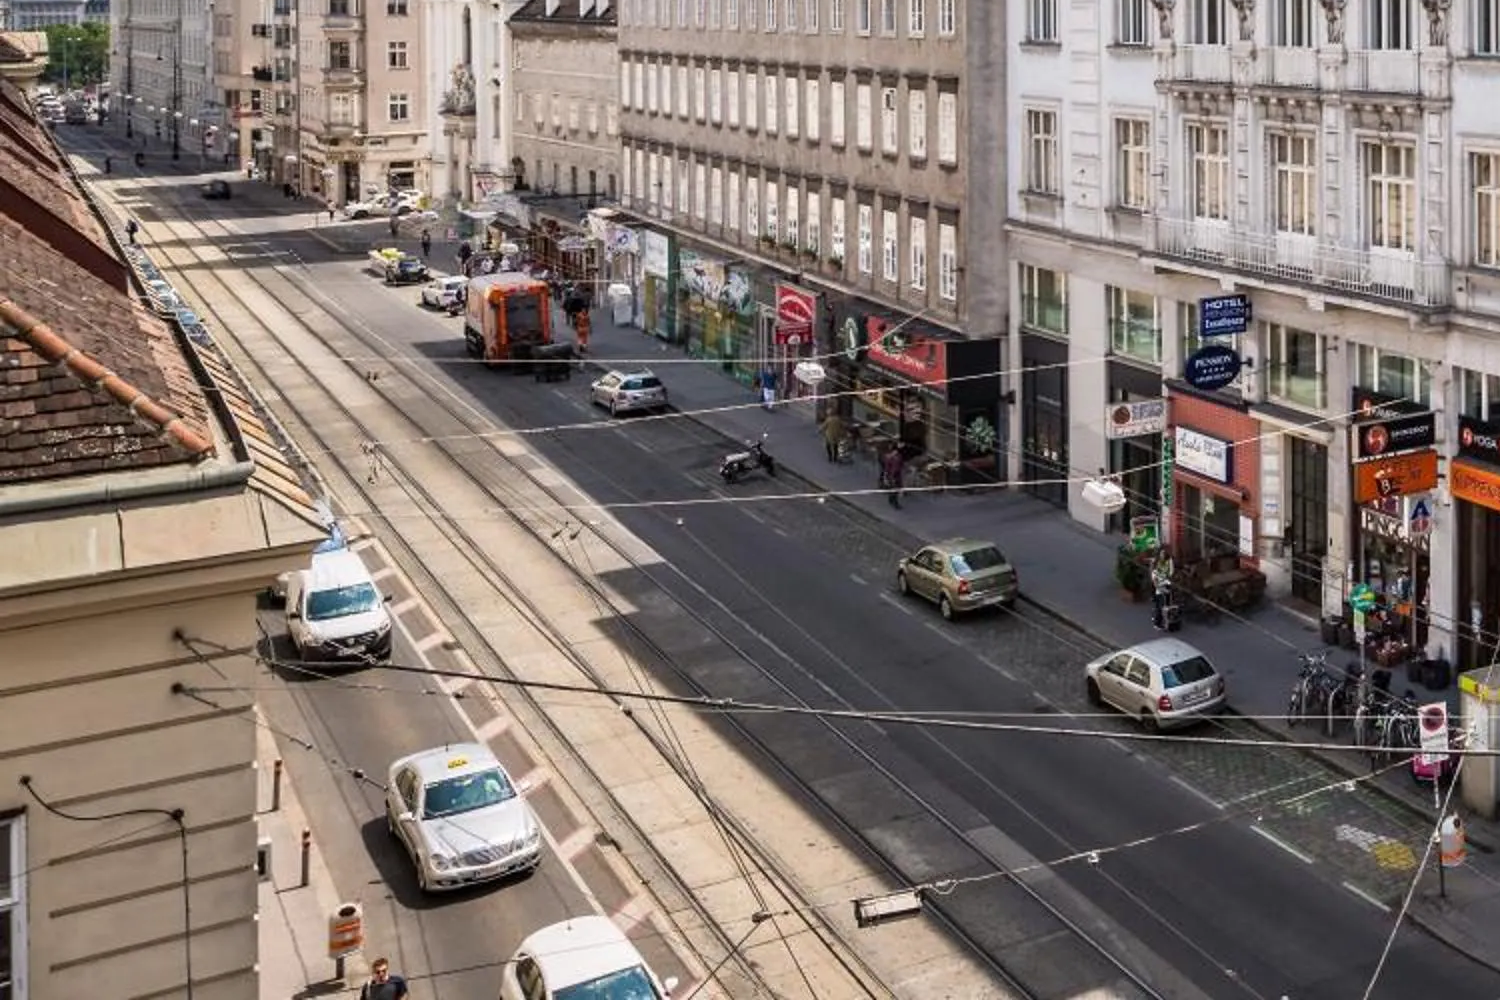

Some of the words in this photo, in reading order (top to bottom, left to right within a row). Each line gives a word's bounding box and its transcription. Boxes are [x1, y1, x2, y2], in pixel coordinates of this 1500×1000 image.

[1205, 298, 1244, 310] HOTEL
[1195, 354, 1232, 370] PENSION
[1474, 435, 1498, 450] YOGA
